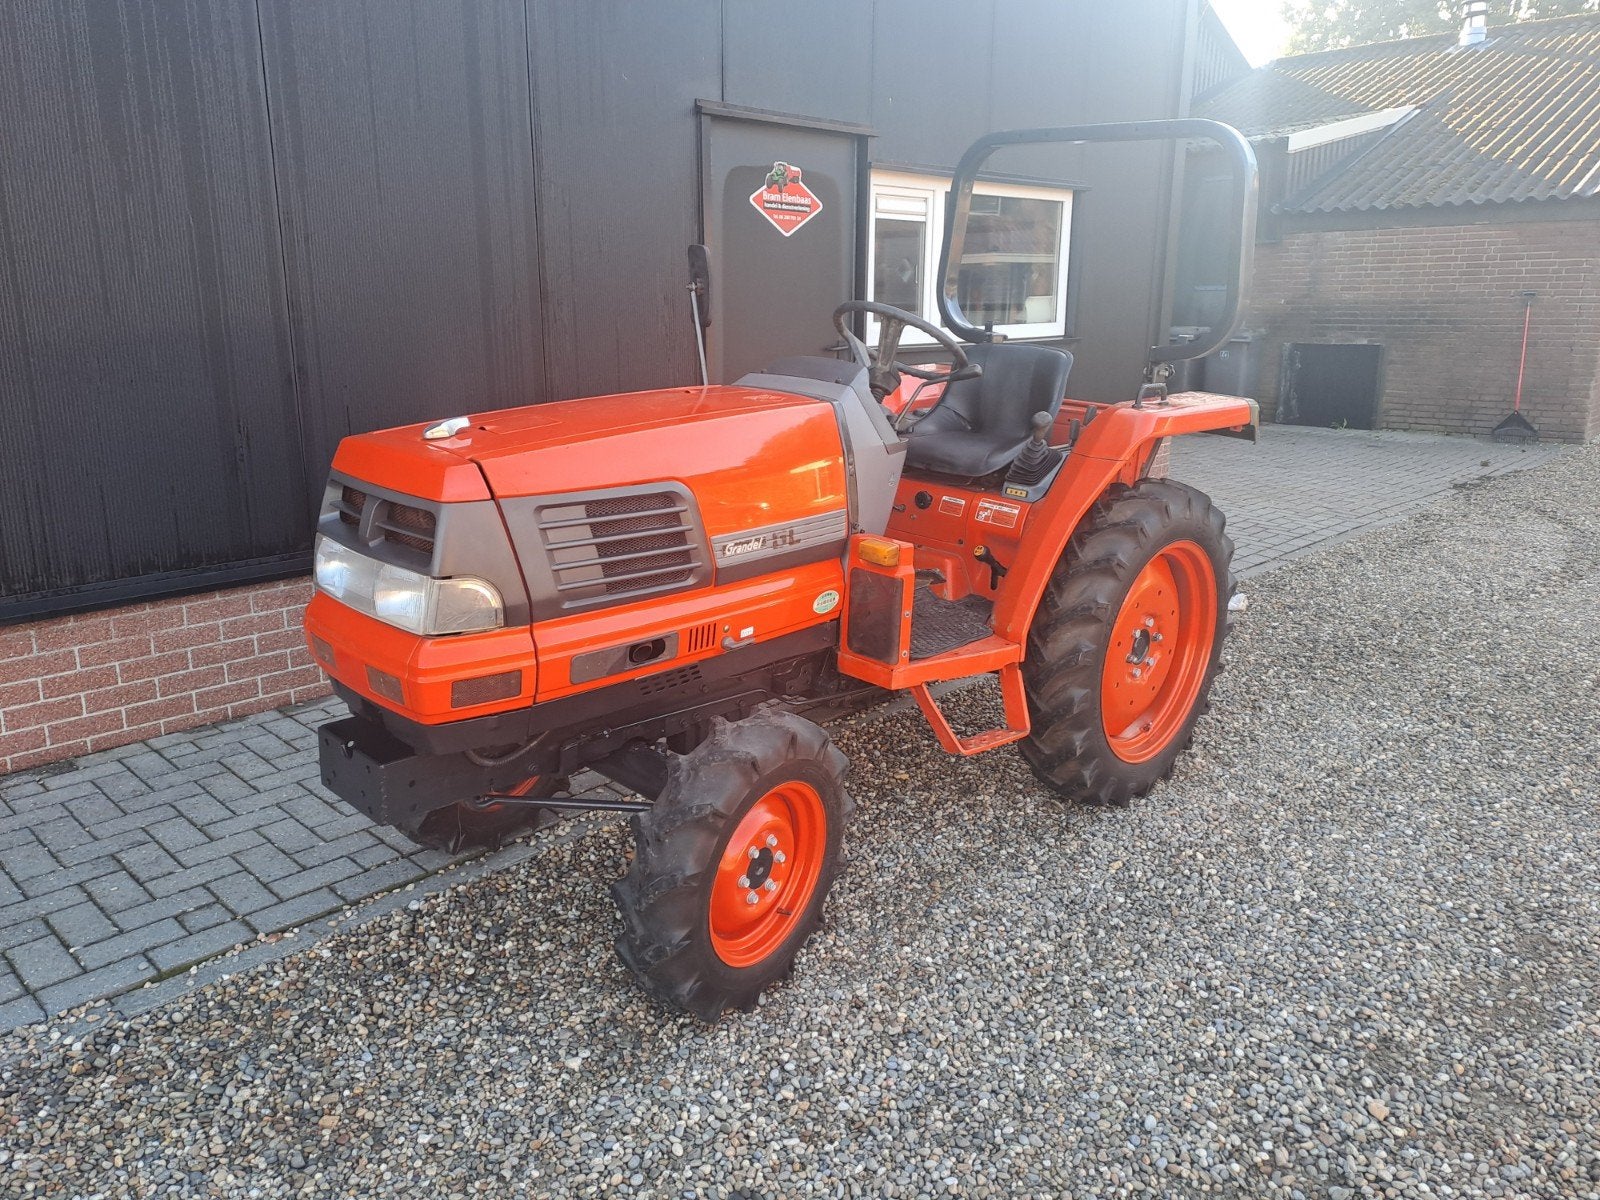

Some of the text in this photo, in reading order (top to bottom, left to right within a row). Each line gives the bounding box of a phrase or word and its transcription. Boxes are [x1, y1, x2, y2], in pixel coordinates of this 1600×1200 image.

[762, 190, 812, 205] Bram Elenbaas
[723, 535, 766, 556] Grandel
